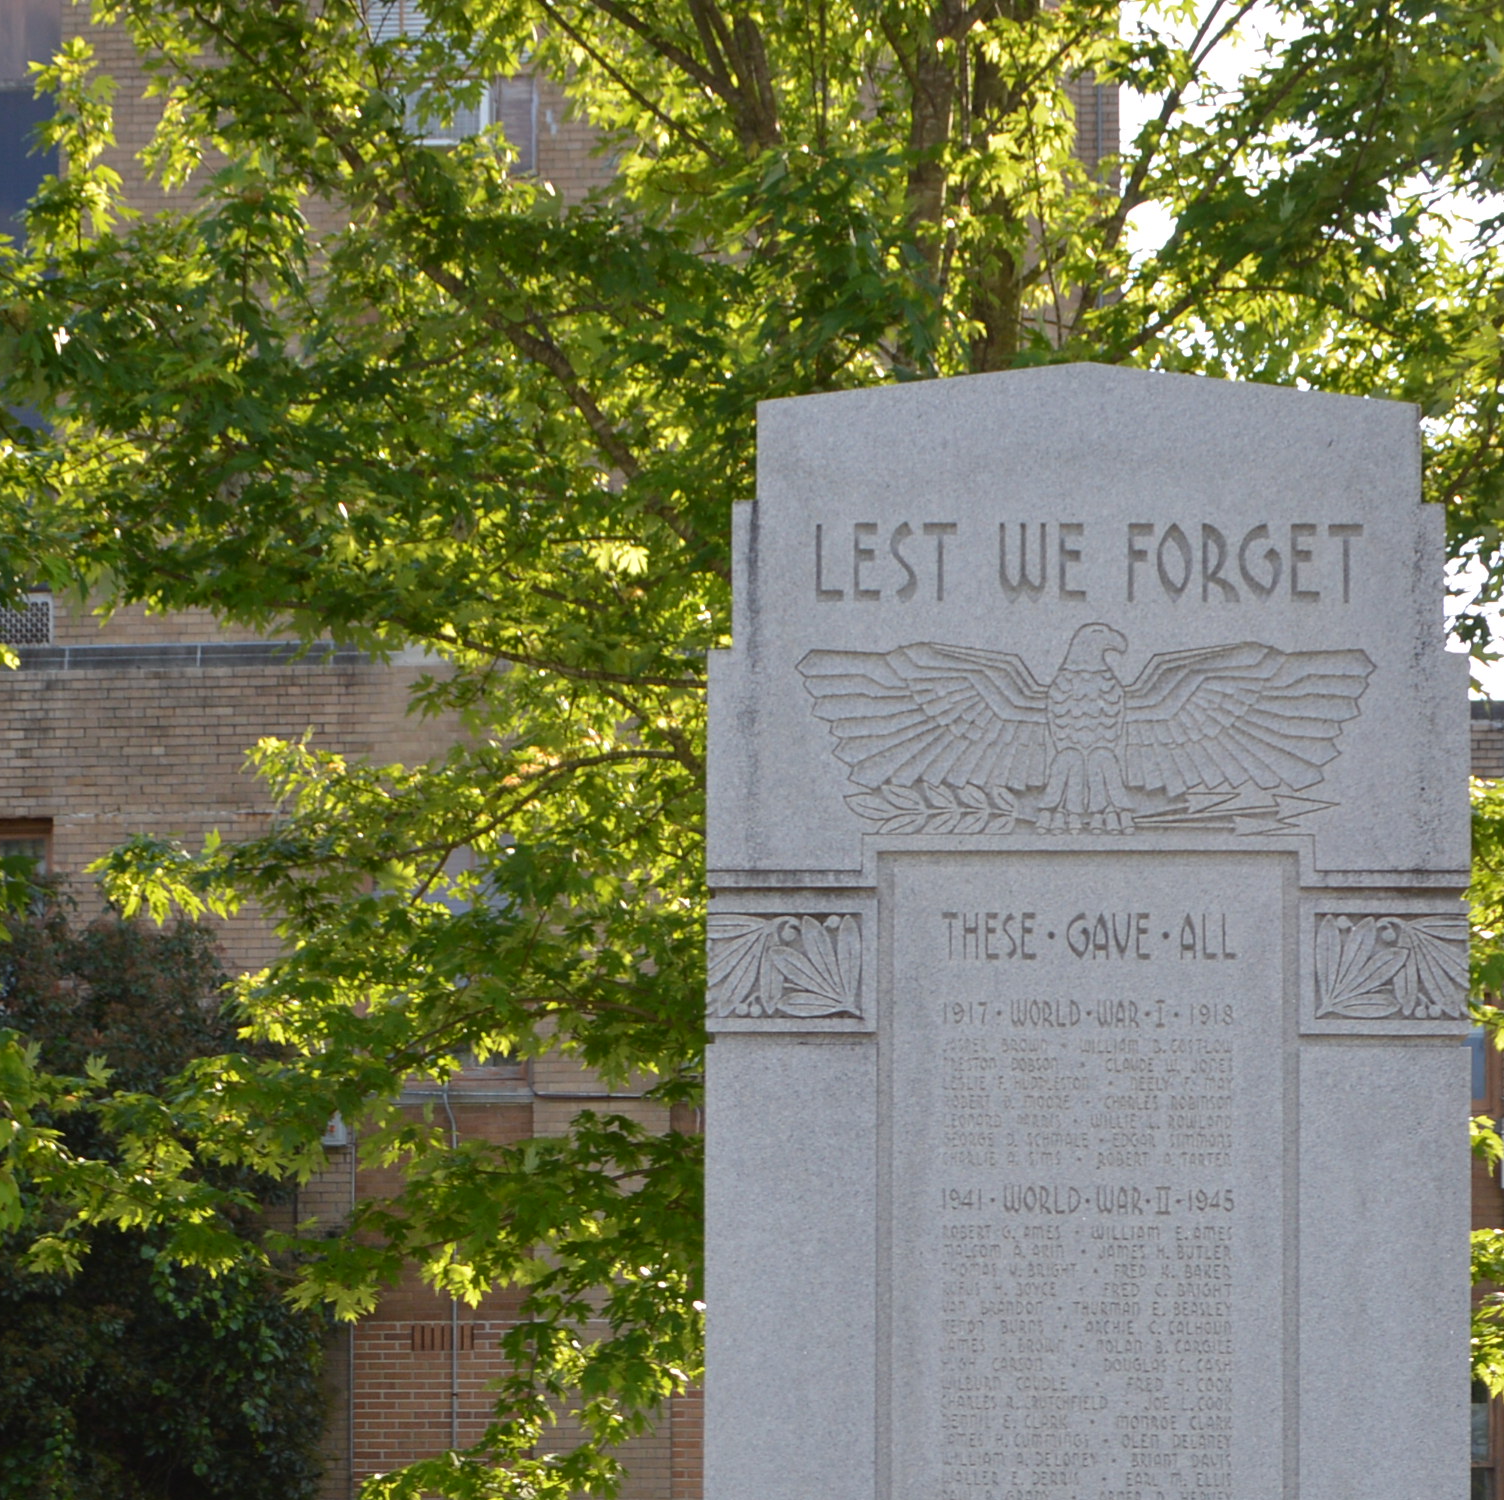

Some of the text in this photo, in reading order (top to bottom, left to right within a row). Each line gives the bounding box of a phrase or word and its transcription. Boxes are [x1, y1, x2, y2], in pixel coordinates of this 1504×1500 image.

[816, 522, 1365, 604] LEST WE FORGET
[942, 912, 1236, 960] THESE GAVE ALL
[942, 1000, 1234, 1028] 1917 WORLD WAR I 1918
[942, 1186, 1235, 1215] 1941 WORLD WAR II 1945
